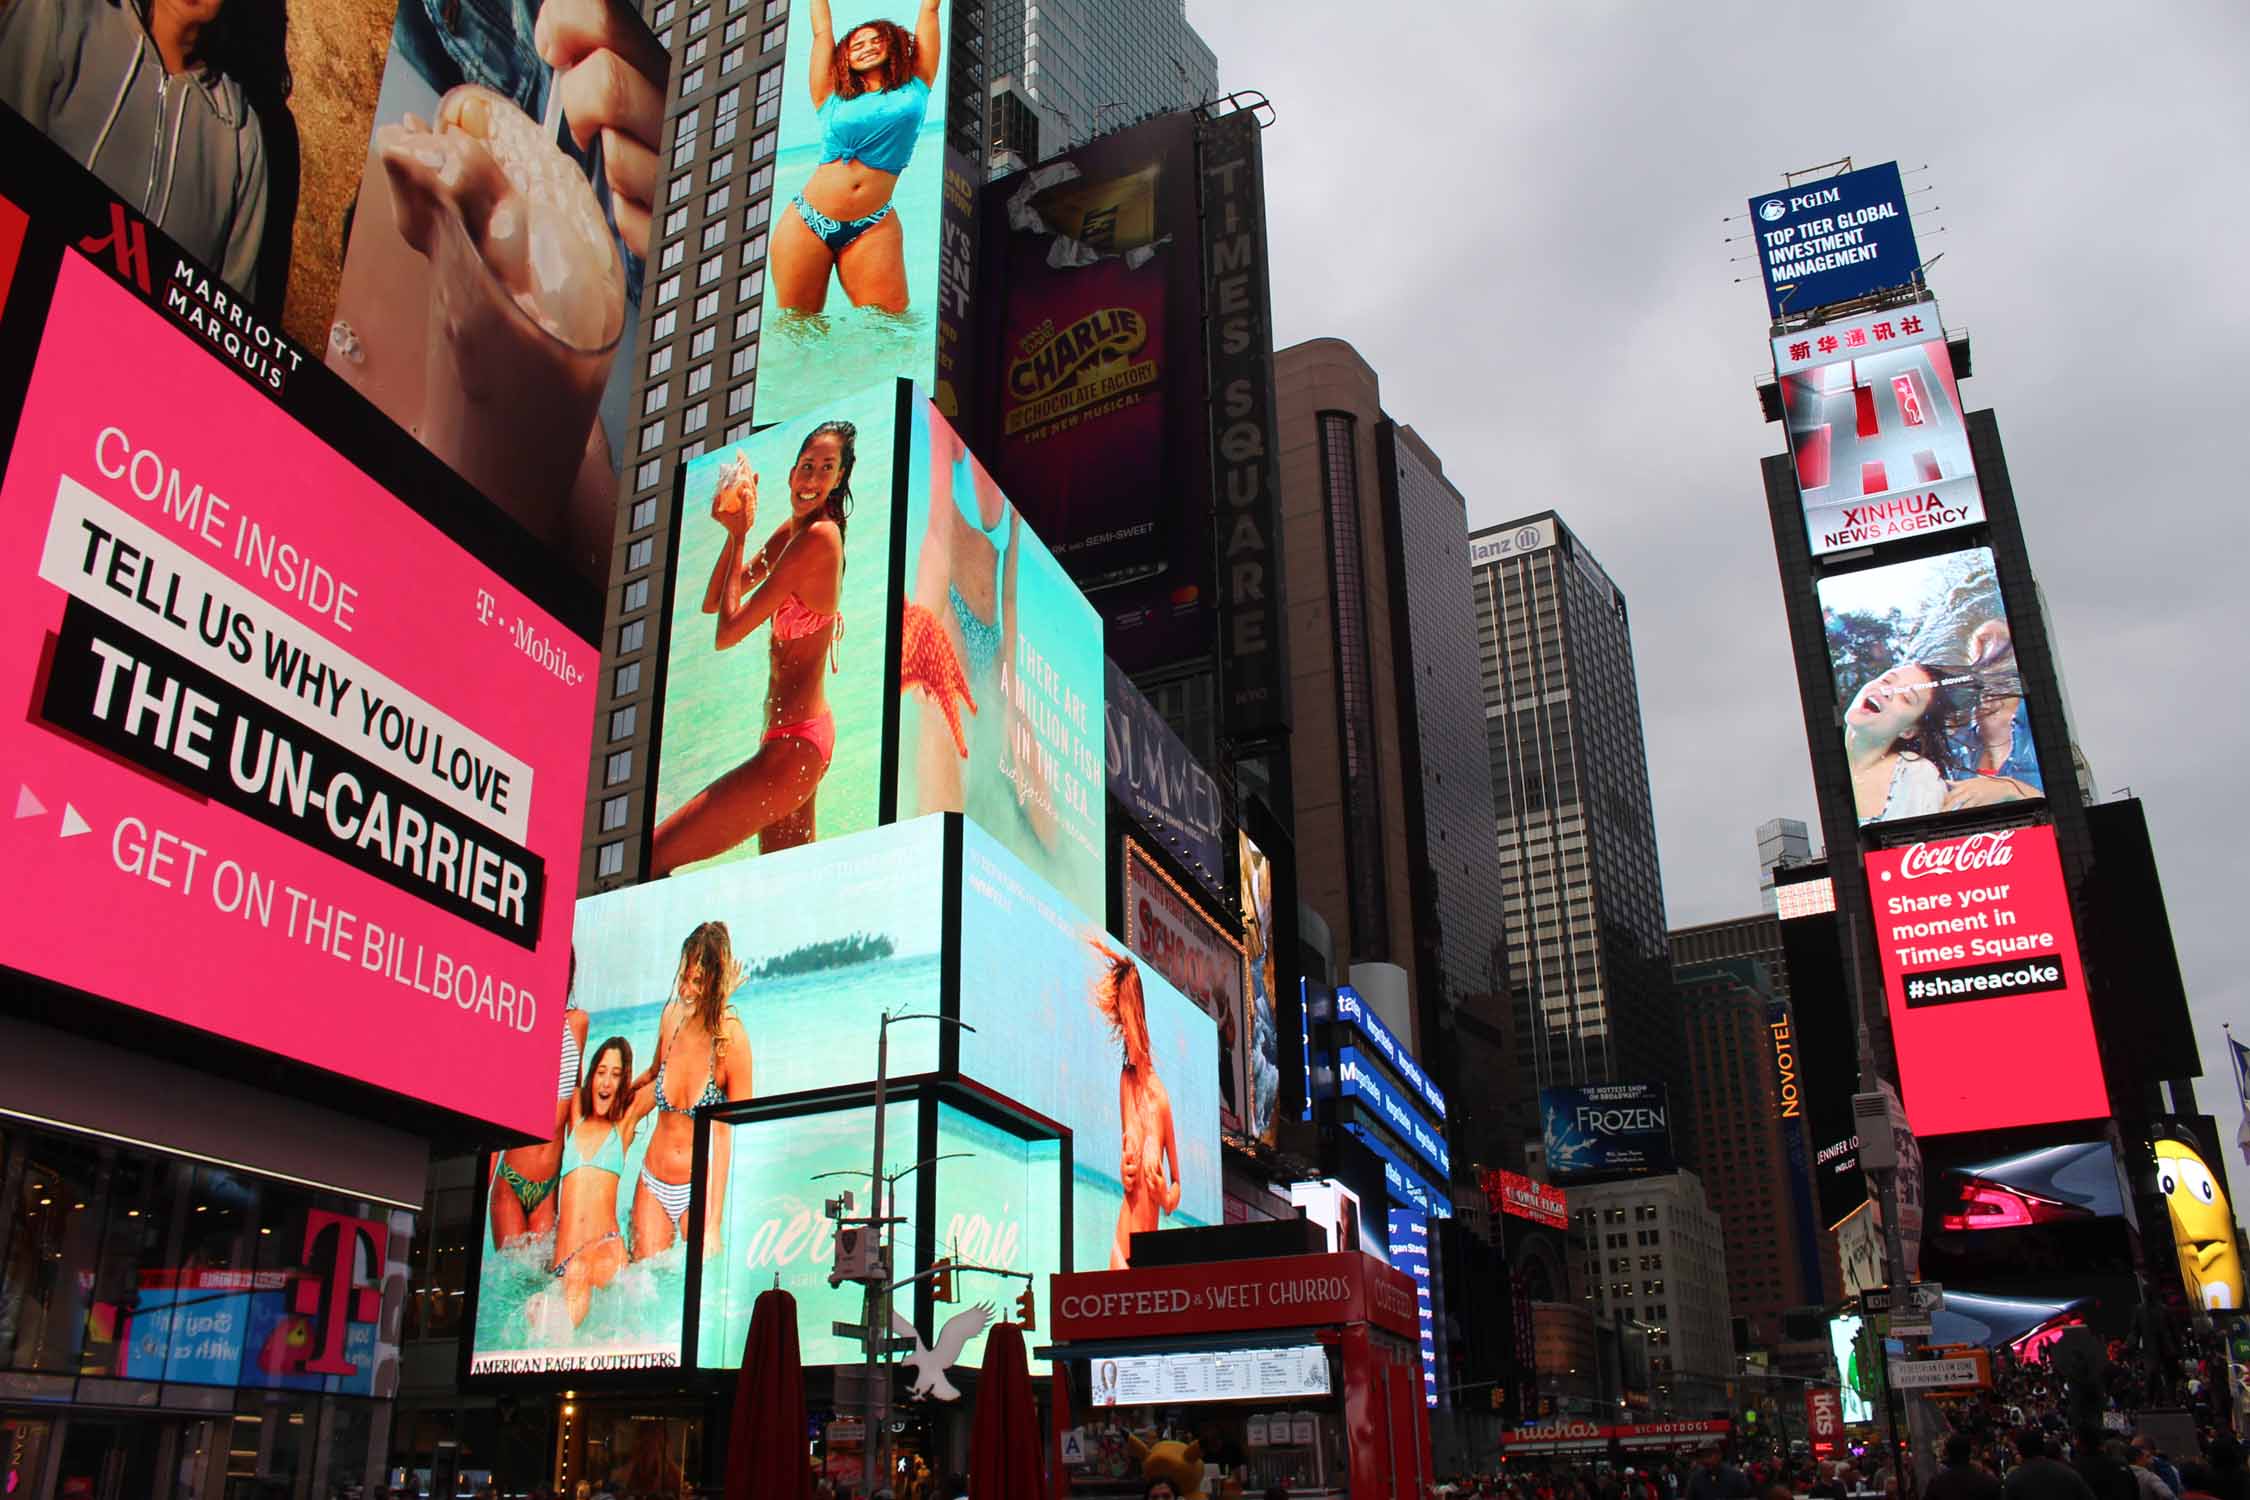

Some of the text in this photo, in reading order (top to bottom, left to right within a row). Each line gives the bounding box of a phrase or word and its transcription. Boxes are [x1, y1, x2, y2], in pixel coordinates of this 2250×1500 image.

[1790, 187, 1840, 212] PGIM
[1764, 202, 1898, 247] TOP TIER GLOBAL
[1768, 228, 1864, 265] INVESTMENT
[1206, 159, 1252, 354] TIMES
[1771, 243, 1878, 282] MANAGEMENT
[174, 259, 302, 373] MARRIOTT
[1789, 315, 1924, 361] 新华通讯社
[168, 287, 284, 390] MARQUIS
[1012, 310, 1138, 396] CHARLIE
[1024, 384, 1097, 424] CHOCOLATE
[1102, 364, 1153, 394] FACTORY
[1084, 394, 1142, 420] MUSICAL
[95, 426, 359, 632] COME INSIDE
[1220, 379, 1267, 655] SQUARE
[1824, 507, 1969, 547] NEWS AGENCY
[1843, 492, 1944, 527] XINHUA
[1085, 522, 1155, 546] SEMI-SWEET
[82, 518, 511, 815] TELL US WHY YOU LOVE
[1019, 634, 1087, 735] THERE ARE
[1000, 661, 1009, 697] A
[1015, 674, 1069, 757] MILLION
[1073, 737, 1101, 789] FISH
[1016, 722, 1031, 764] IN
[1035, 736, 1060, 793] THE
[90, 637, 529, 927] THE UN-CARRIER
[1888, 884, 2011, 915] Share your
[112, 817, 538, 1033] GET ON THE BILLBOARD
[1892, 909, 2016, 941] moment in
[1896, 932, 2054, 967] Times Square
[1908, 964, 2059, 999] #shareacoke
[1770, 1013, 1800, 1118] NOVOTEL
[1576, 1106, 1666, 1135] FROZEN
[1817, 1139, 1848, 1165] JENNIFER
[946, 1203, 1019, 1268] aerie
[1061, 1289, 1190, 1319] COFFEED
[1205, 1284, 1263, 1310] SWEET
[1269, 1275, 1351, 1306] CHURROS
[473, 1352, 677, 1375] AMERICAN EAGLE OUTFITTERS
[1513, 1421, 1600, 1442] nuchas
[1814, 1392, 1836, 1436] tkts
[1066, 1435, 1081, 1455] A
